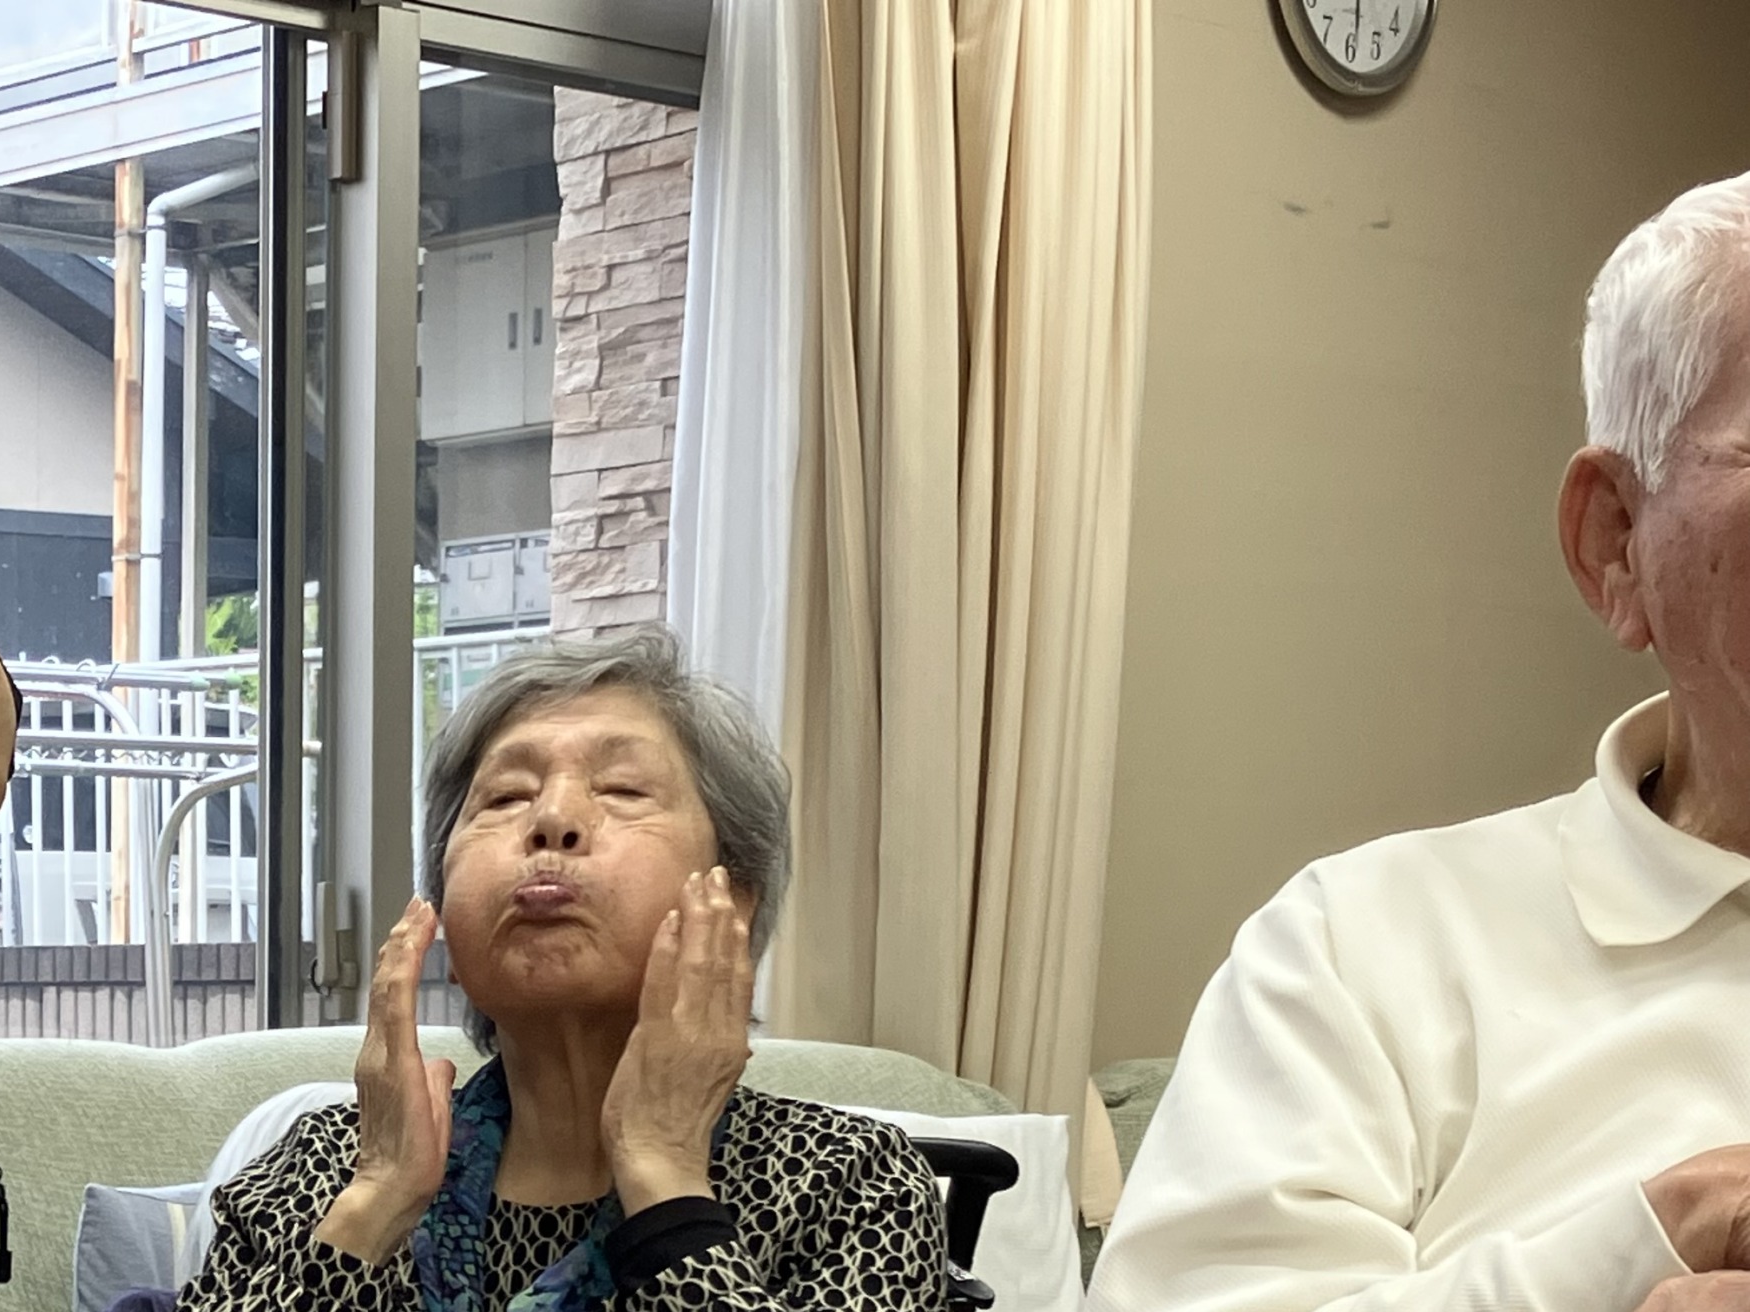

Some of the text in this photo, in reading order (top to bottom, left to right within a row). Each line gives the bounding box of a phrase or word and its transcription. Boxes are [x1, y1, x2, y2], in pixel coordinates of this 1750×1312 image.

[1322, 14, 1334, 46] 7
[1388, 4, 1400, 37] 4
[1345, 32, 1356, 63] 6
[1370, 31, 1381, 61] 5
